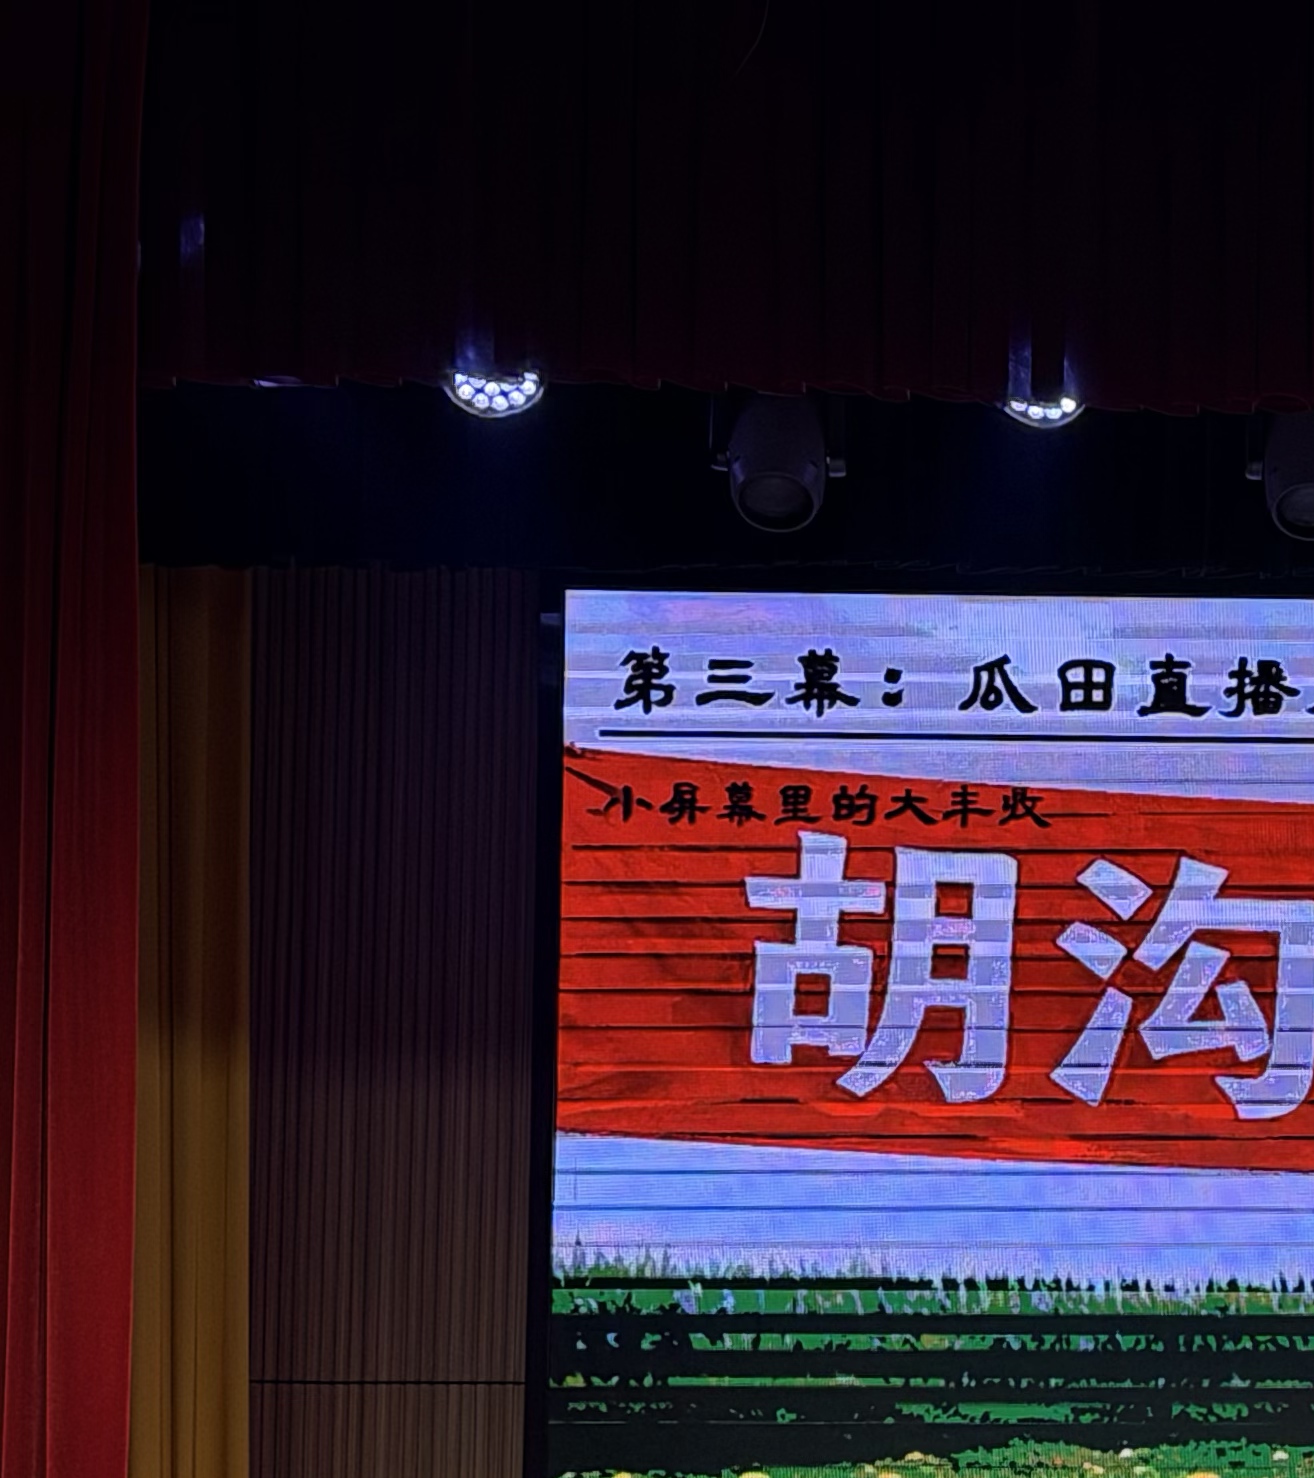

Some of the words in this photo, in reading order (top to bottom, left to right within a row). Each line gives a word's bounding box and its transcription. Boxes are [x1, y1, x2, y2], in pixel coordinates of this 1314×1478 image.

[601, 781, 1052, 828] 小屏幕里的大丰收
